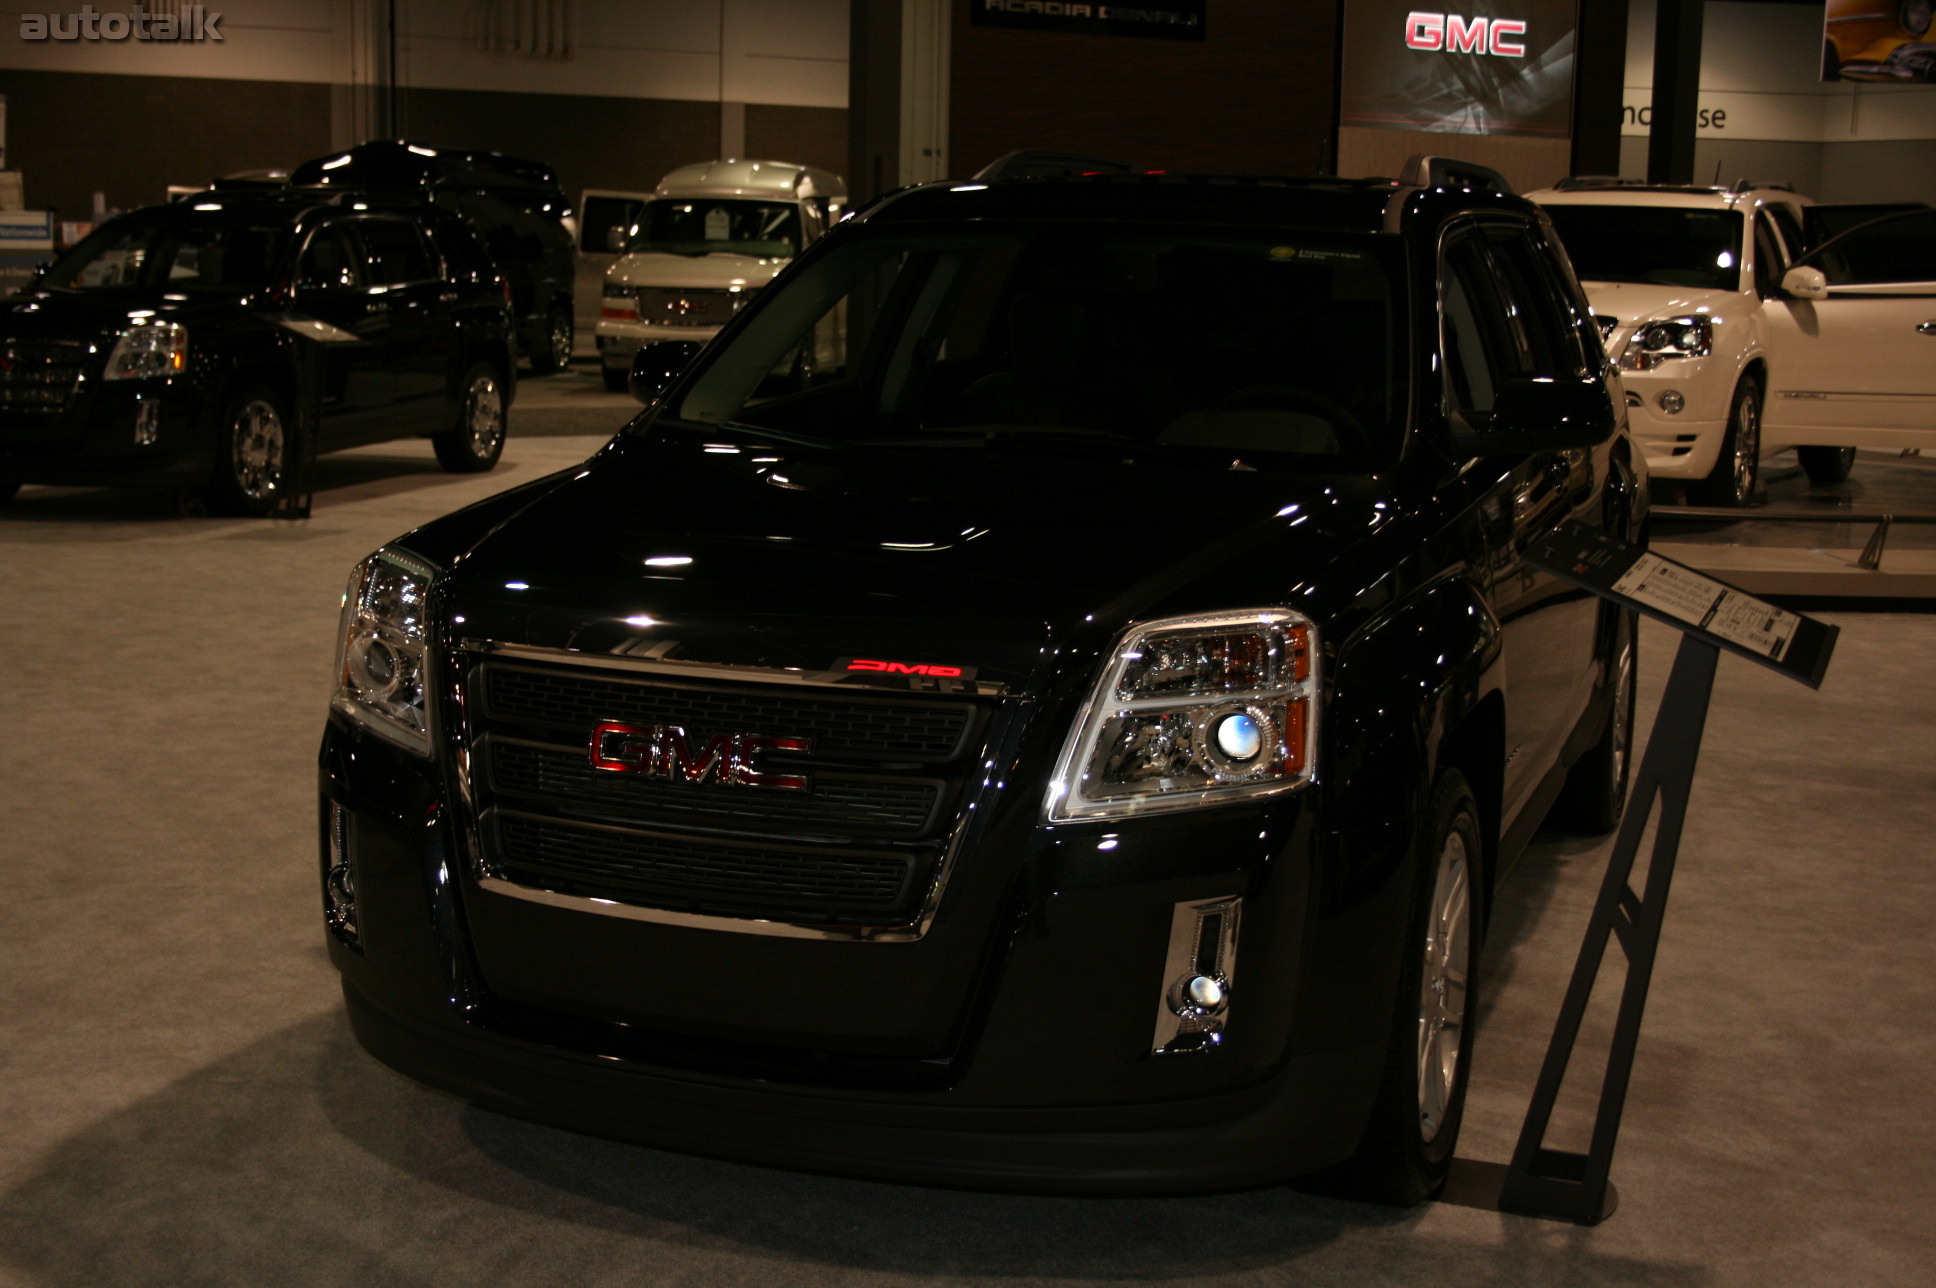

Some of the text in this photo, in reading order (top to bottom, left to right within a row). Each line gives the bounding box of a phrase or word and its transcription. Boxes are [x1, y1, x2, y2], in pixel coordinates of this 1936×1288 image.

[985, 0, 1198, 26] ACADIA DENALI
[1405, 11, 1526, 58] GMC
[589, 717, 812, 790] GMC
